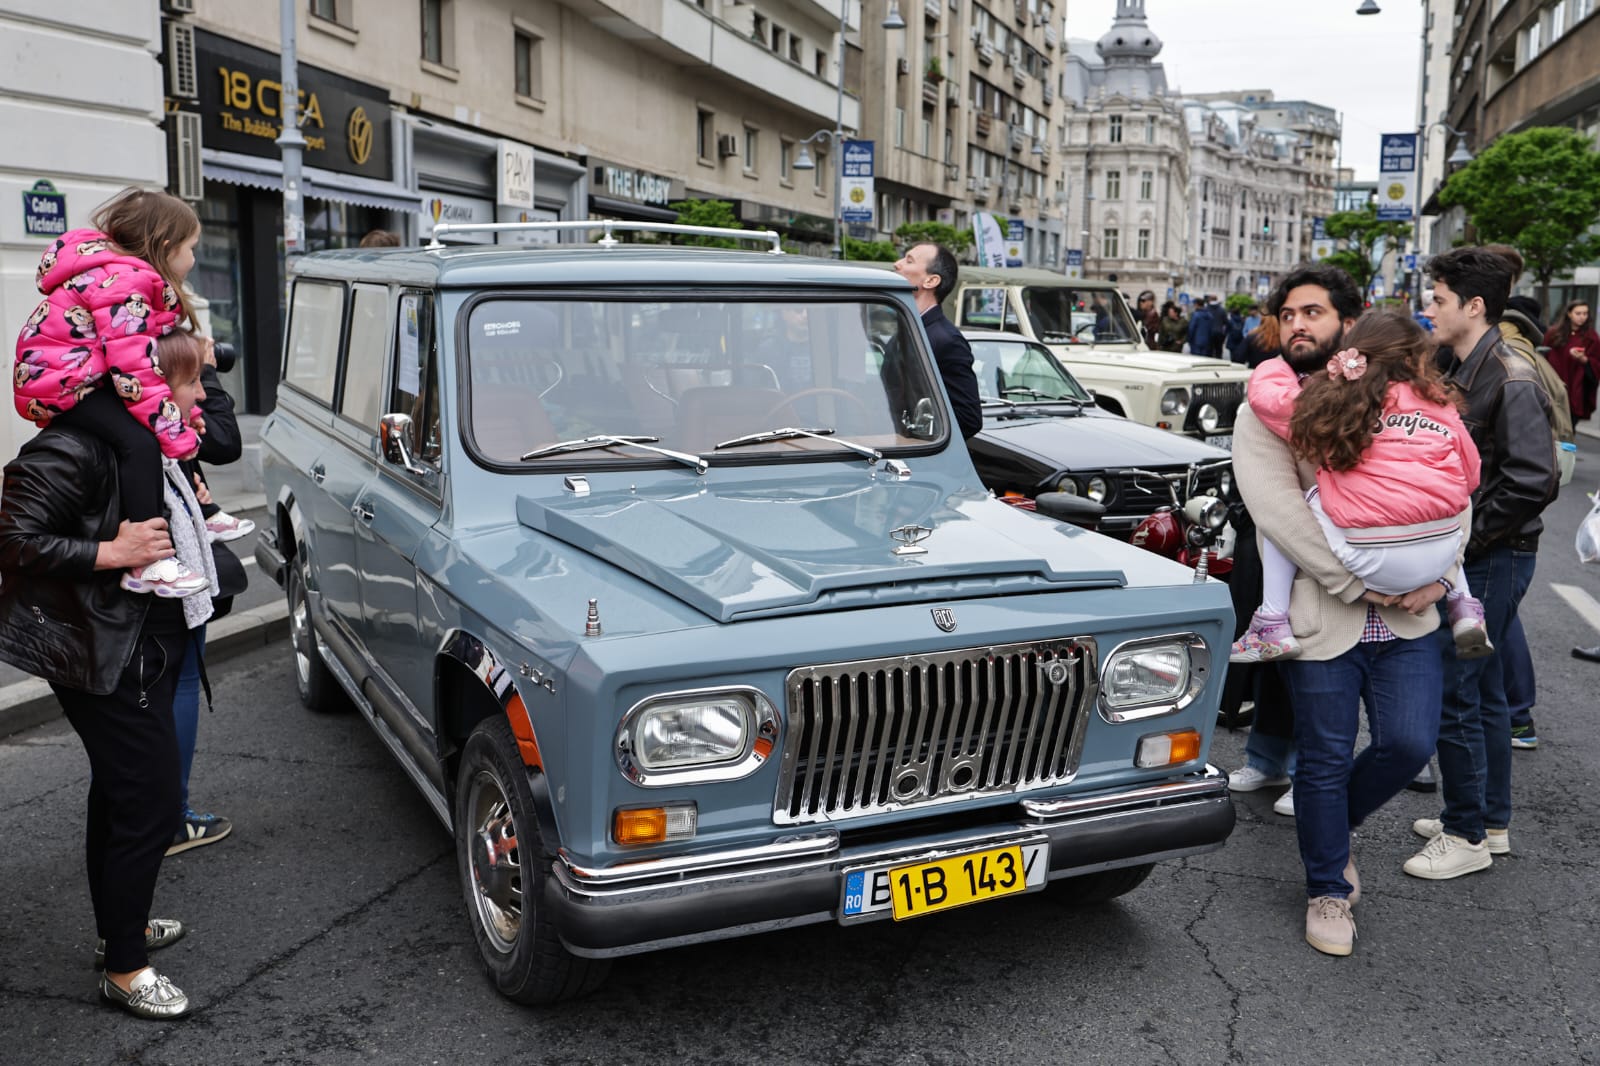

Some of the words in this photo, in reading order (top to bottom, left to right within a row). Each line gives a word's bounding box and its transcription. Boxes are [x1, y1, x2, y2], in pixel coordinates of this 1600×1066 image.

[219, 67, 252, 110] 18
[220, 111, 243, 132] The
[244, 117, 278, 139] Bubble
[607, 166, 631, 198] THE
[634, 173, 671, 205] LOBBY
[32, 196, 58, 214] Calea
[27, 215, 65, 233] Victoriei
[963, 852, 1017, 896] 143
[845, 894, 861, 910] RO
